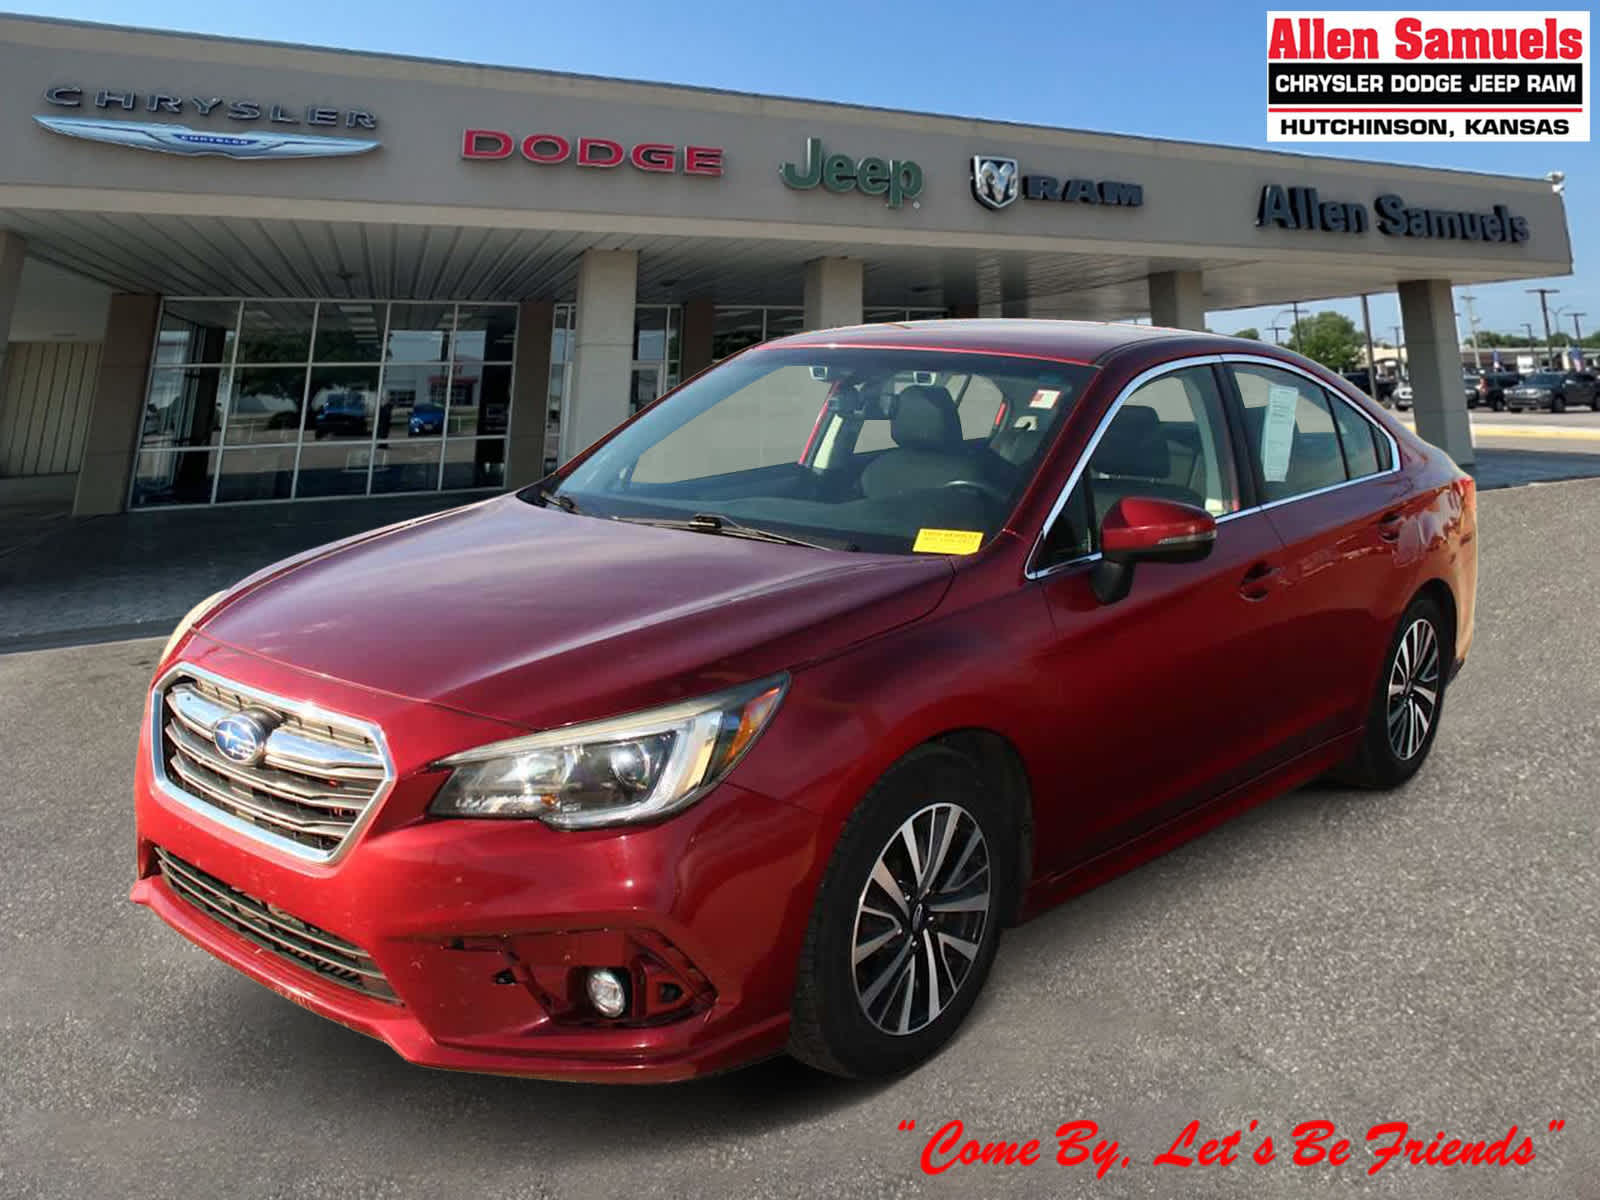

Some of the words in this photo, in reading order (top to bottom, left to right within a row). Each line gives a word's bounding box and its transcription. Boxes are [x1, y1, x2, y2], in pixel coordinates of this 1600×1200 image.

[44, 85, 377, 130] CHRYSLER
[461, 128, 724, 177] DODGE
[779, 136, 924, 209] Jeep
[1023, 175, 1144, 208] RAM
[1256, 184, 1370, 233] Allen
[1374, 193, 1530, 243] Samuels
